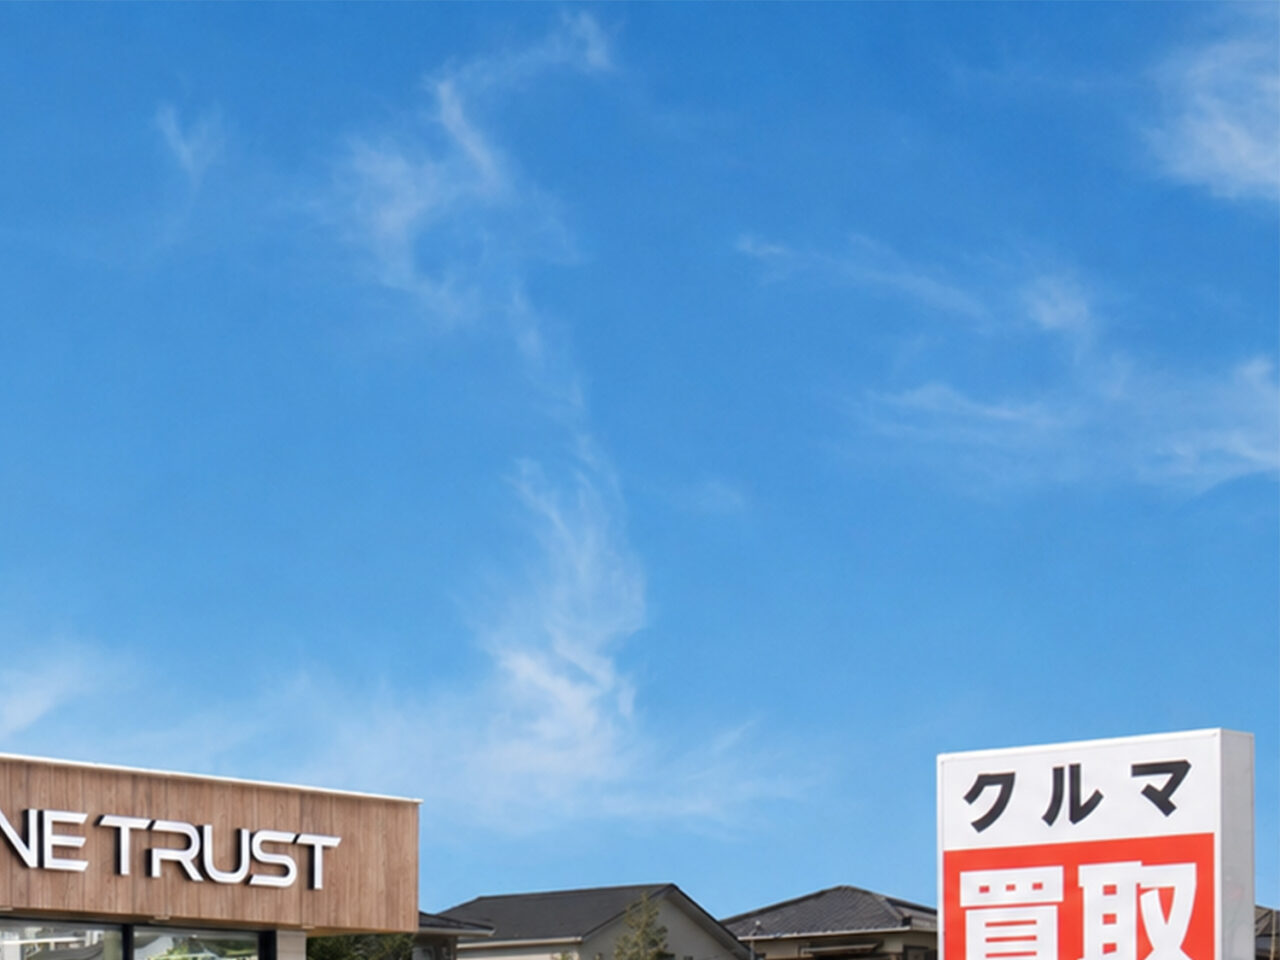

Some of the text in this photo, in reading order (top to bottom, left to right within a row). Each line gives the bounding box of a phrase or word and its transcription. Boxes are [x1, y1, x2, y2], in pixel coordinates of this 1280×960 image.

[963, 759, 1192, 833] クルマ
[96, 814, 342, 890] TRUST
